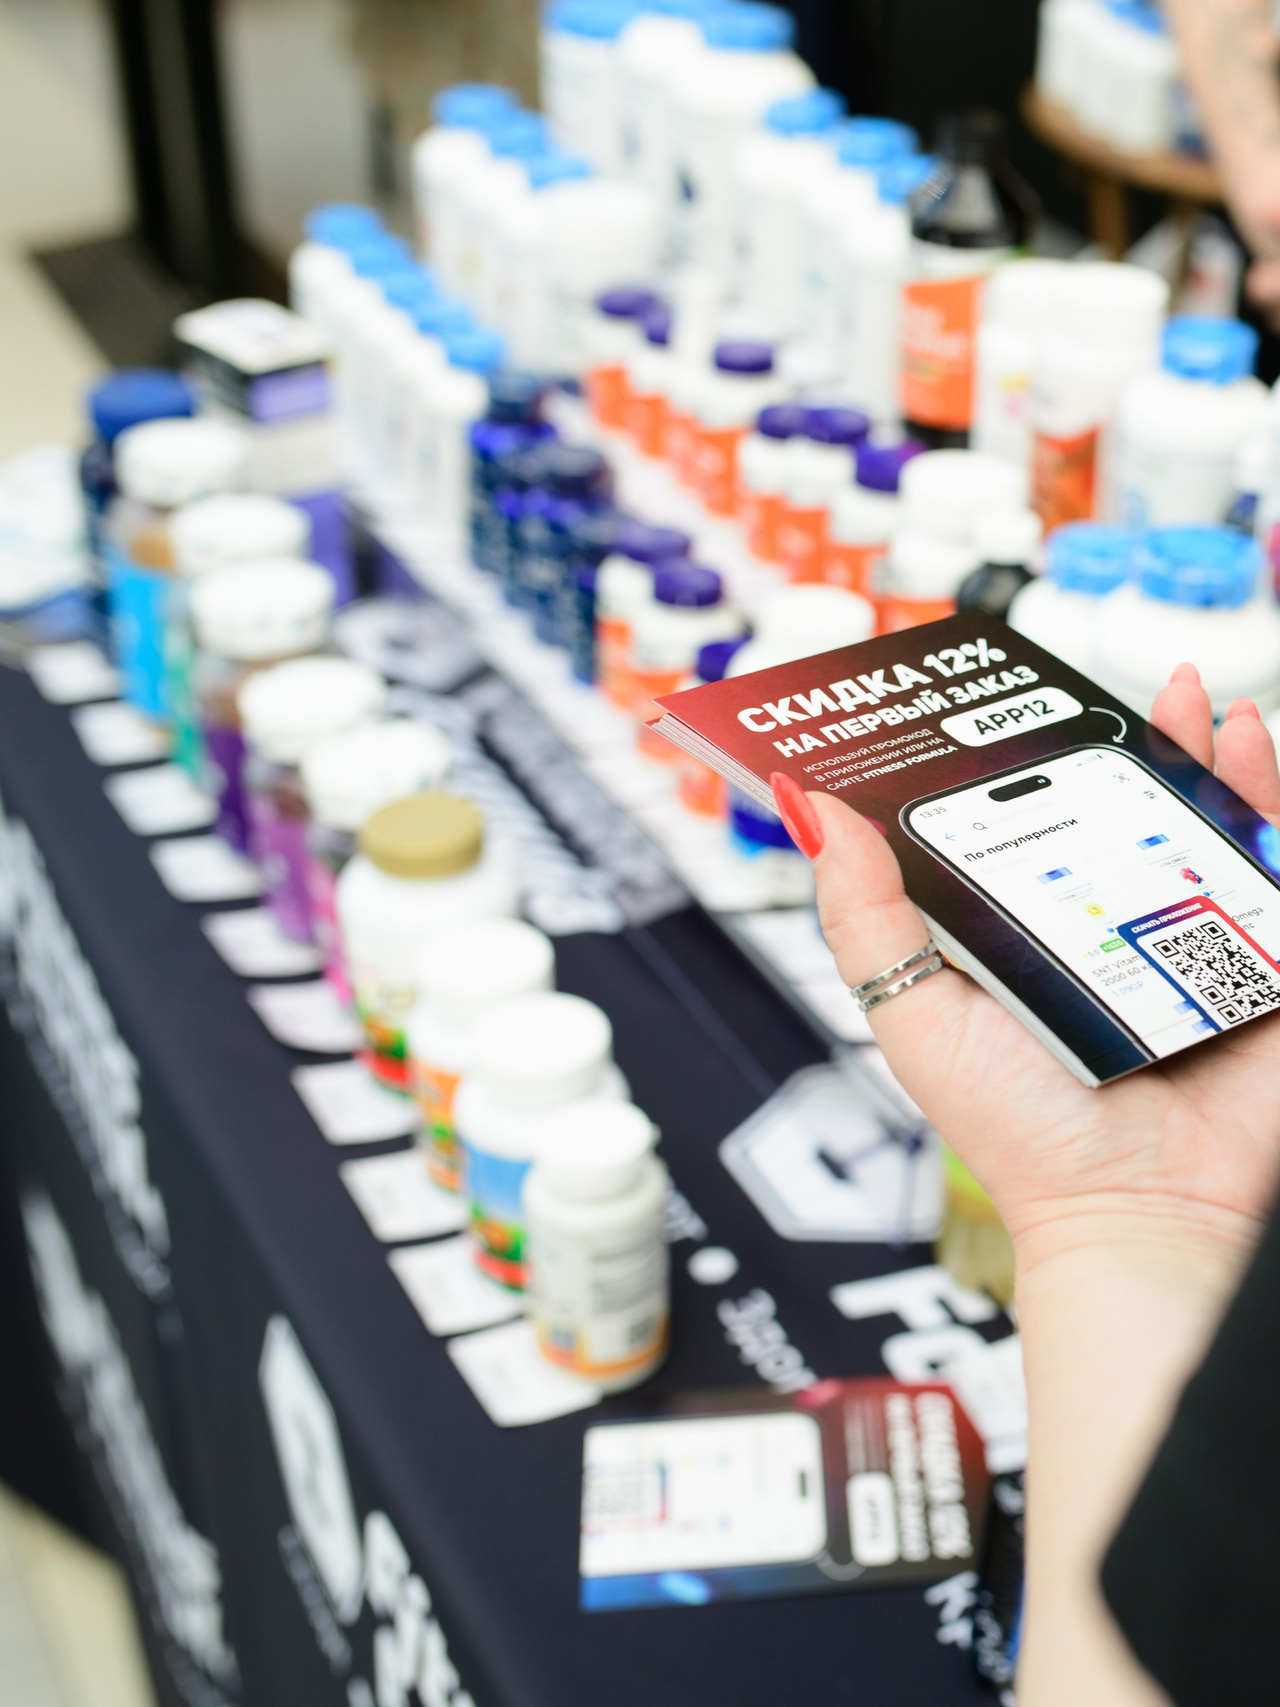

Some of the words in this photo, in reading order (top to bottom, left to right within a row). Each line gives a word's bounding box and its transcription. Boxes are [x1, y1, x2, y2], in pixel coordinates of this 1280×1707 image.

[737, 663, 933, 733] СКИДКА
[923, 638, 1007, 677] 12%
[772, 732, 827, 758] НА
[819, 689, 952, 743] ПЕРВЫЙ
[945, 665, 1040, 704] ЗАКАЗ
[973, 699, 1055, 736] APP12
[802, 746, 871, 774] ИСПОЛЬЗУЙ
[869, 728, 935, 753] ПРОМОКОД
[814, 774, 826, 783] В
[824, 750, 904, 780] ПРИЛОЖЕНИИ
[901, 741, 928, 755] ИЛИ
[926, 737, 946, 747] НА
[826, 774, 866, 791] САЙТЕ
[862, 761, 908, 780] FITNESS
[904, 745, 959, 766] FORMULA
[919, 806, 948, 820] 13:35
[964, 849, 985, 862] По
[986, 817, 1079, 853] популярности
[1131, 918, 1162, 934] СКАЧАТЬ
[1157, 902, 1203, 924] ПРИЛОЖЕНИЕ
[1231, 907, 1264, 922] Omega
[1092, 965, 1112, 978] SNT
[1101, 972, 1127, 987] 2000
[1127, 966, 1141, 977] 60
